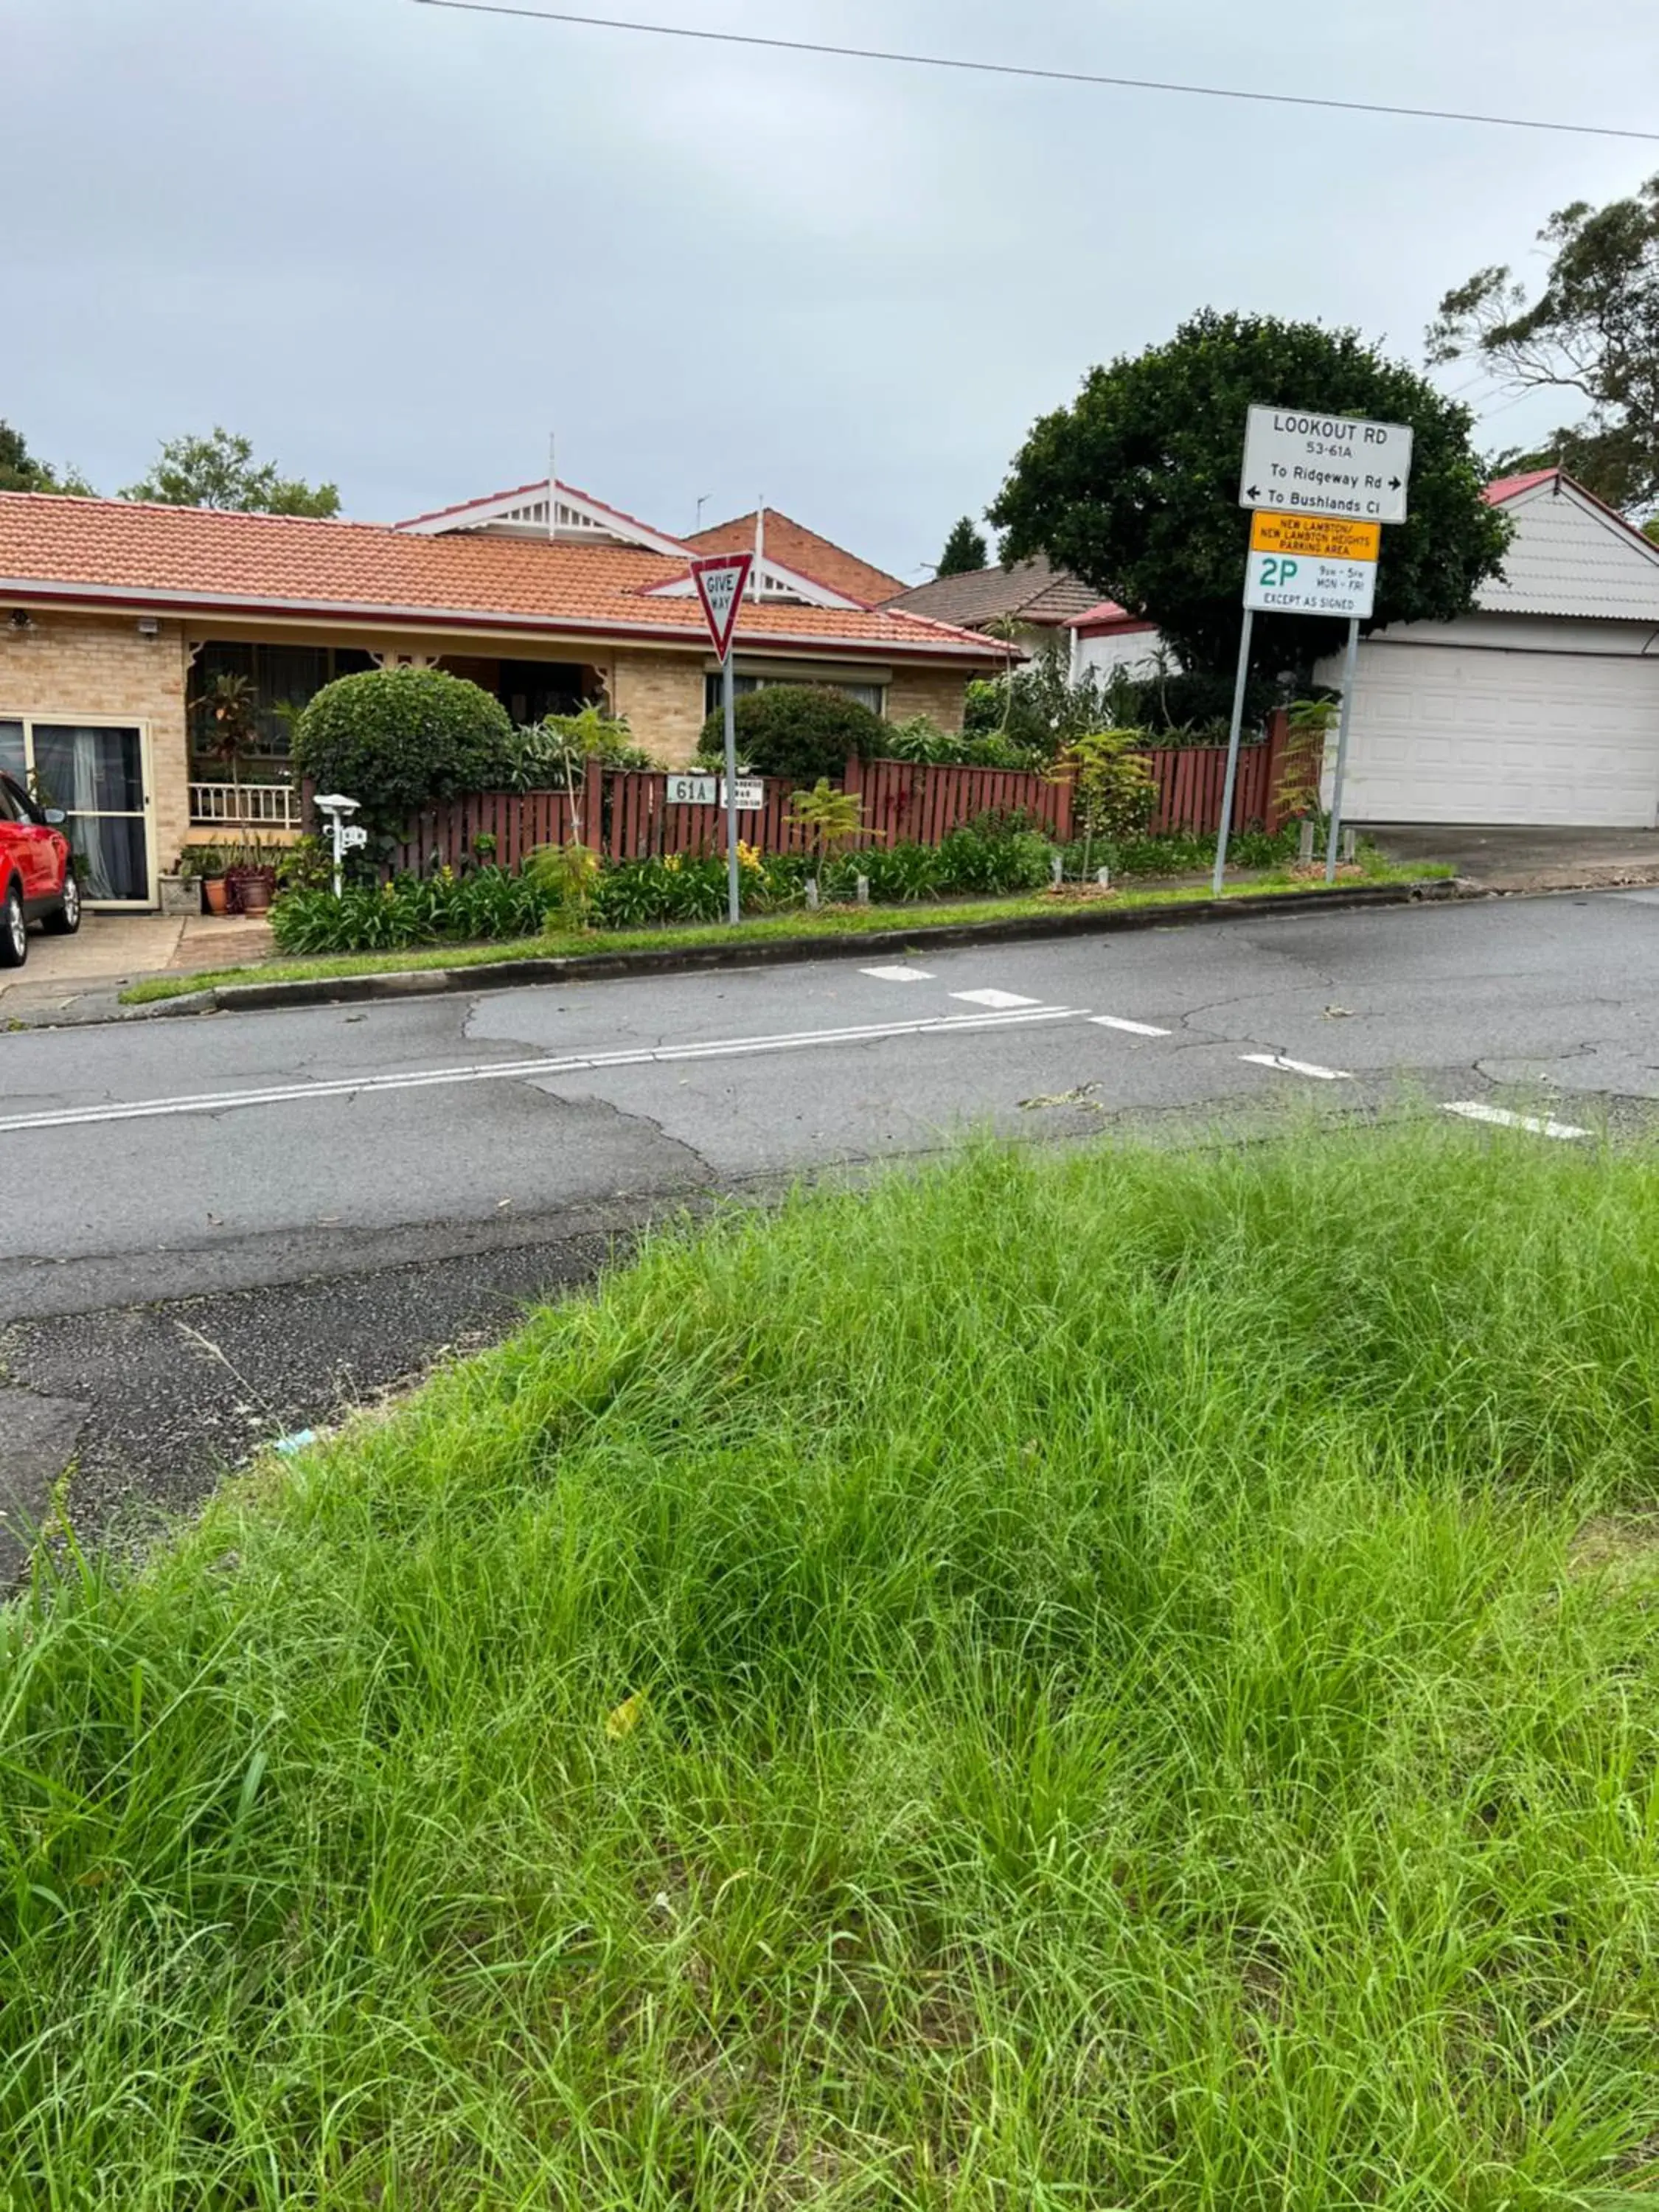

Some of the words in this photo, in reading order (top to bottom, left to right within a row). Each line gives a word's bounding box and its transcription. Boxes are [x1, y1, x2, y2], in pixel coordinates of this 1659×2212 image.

[1273, 414, 1357, 440] LOOKOUT
[1363, 428, 1388, 444] RD
[1306, 442, 1352, 458] 53-61A
[1271, 463, 1287, 478] To
[1293, 467, 1359, 489] Ridgeway
[1365, 476, 1382, 489] Rd
[1268, 490, 1284, 503] To
[1290, 493, 1360, 512] Bushlands
[1367, 501, 1380, 513] Cl
[1280, 518, 1301, 529] NEW
[1261, 528, 1280, 538] NEW
[1284, 530, 1328, 542] LAMBTON
[1332, 535, 1370, 547] HEIGHTS
[1279, 539, 1321, 552] PARKING
[1324, 543, 1350, 555] AREA
[1259, 557, 1298, 586] 2P
[706, 574, 734, 592] GIVE
[1317, 577, 1338, 589] MON
[711, 597, 730, 609] WAY
[1264, 592, 1301, 605] EXCEPT
[1304, 596, 1317, 607] AS
[1321, 597, 1354, 610] SIGNED
[676, 780, 706, 800] 61A
